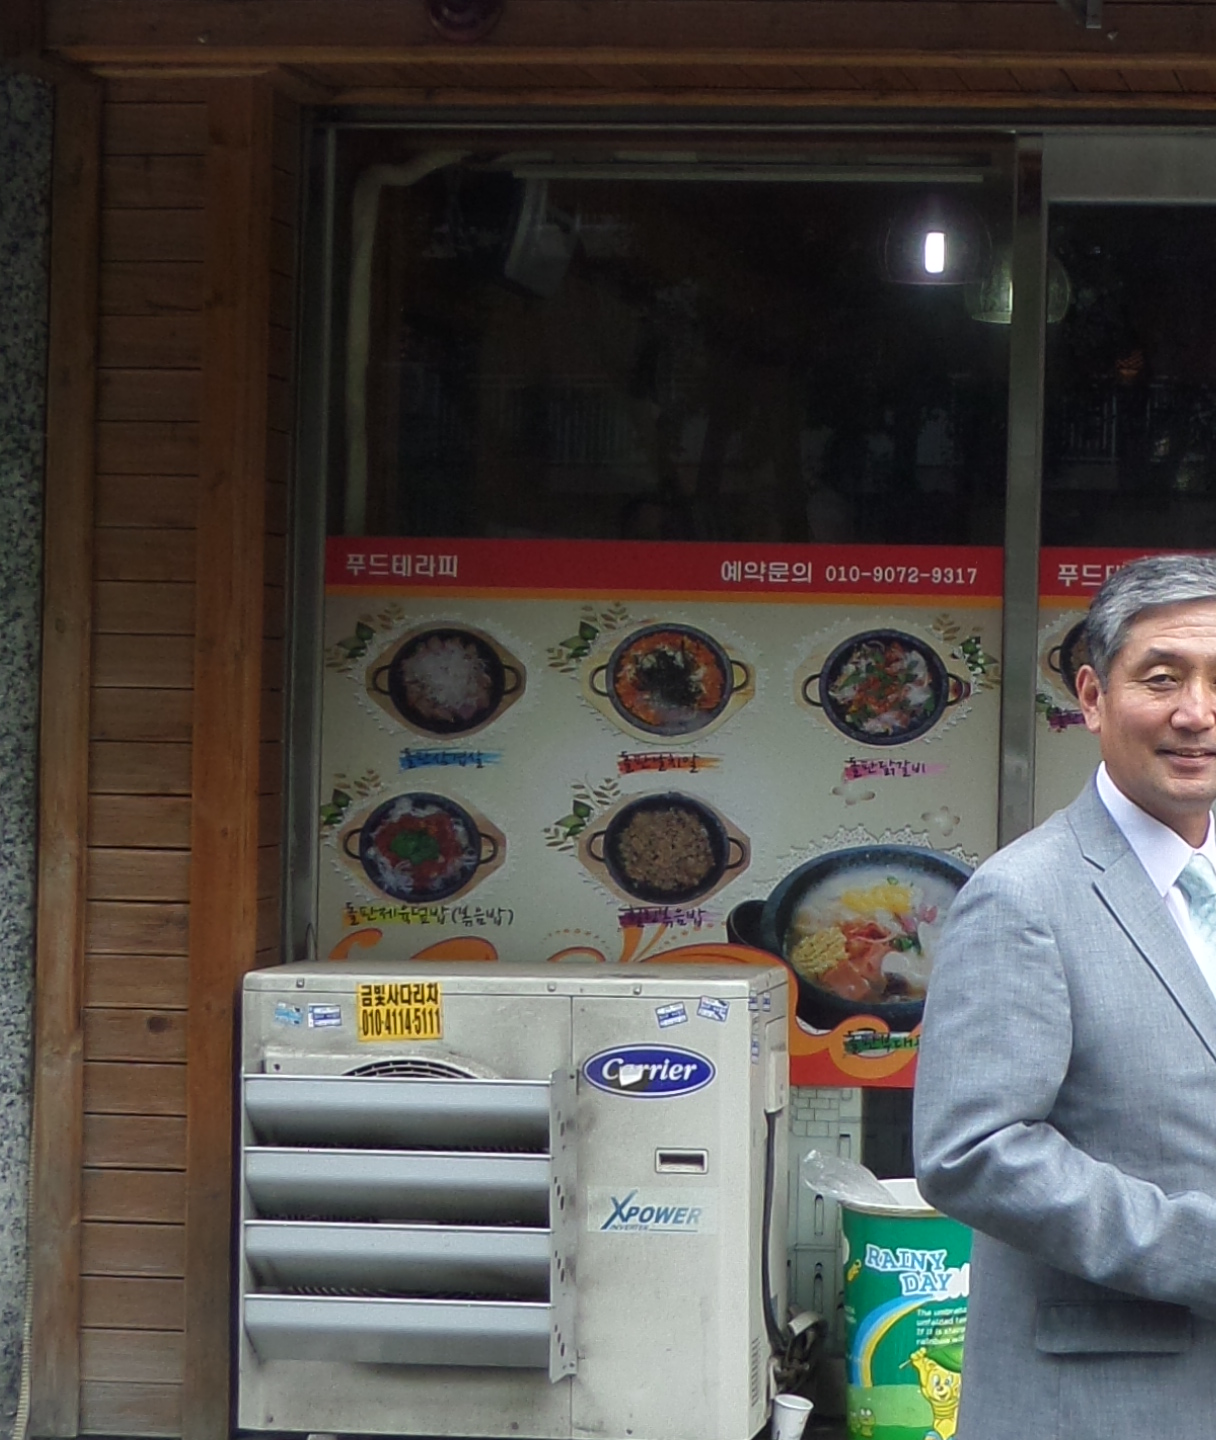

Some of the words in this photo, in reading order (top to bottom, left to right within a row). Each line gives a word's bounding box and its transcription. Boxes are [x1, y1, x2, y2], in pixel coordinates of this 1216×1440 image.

[345, 553, 460, 580] 푸드테라피
[720, 560, 814, 585] 예약문의
[824, 565, 978, 586] 010-9072-9317
[601, 1057, 699, 1082] Crier
[864, 1243, 948, 1273] RAINY
[898, 1271, 953, 1297] DAY
